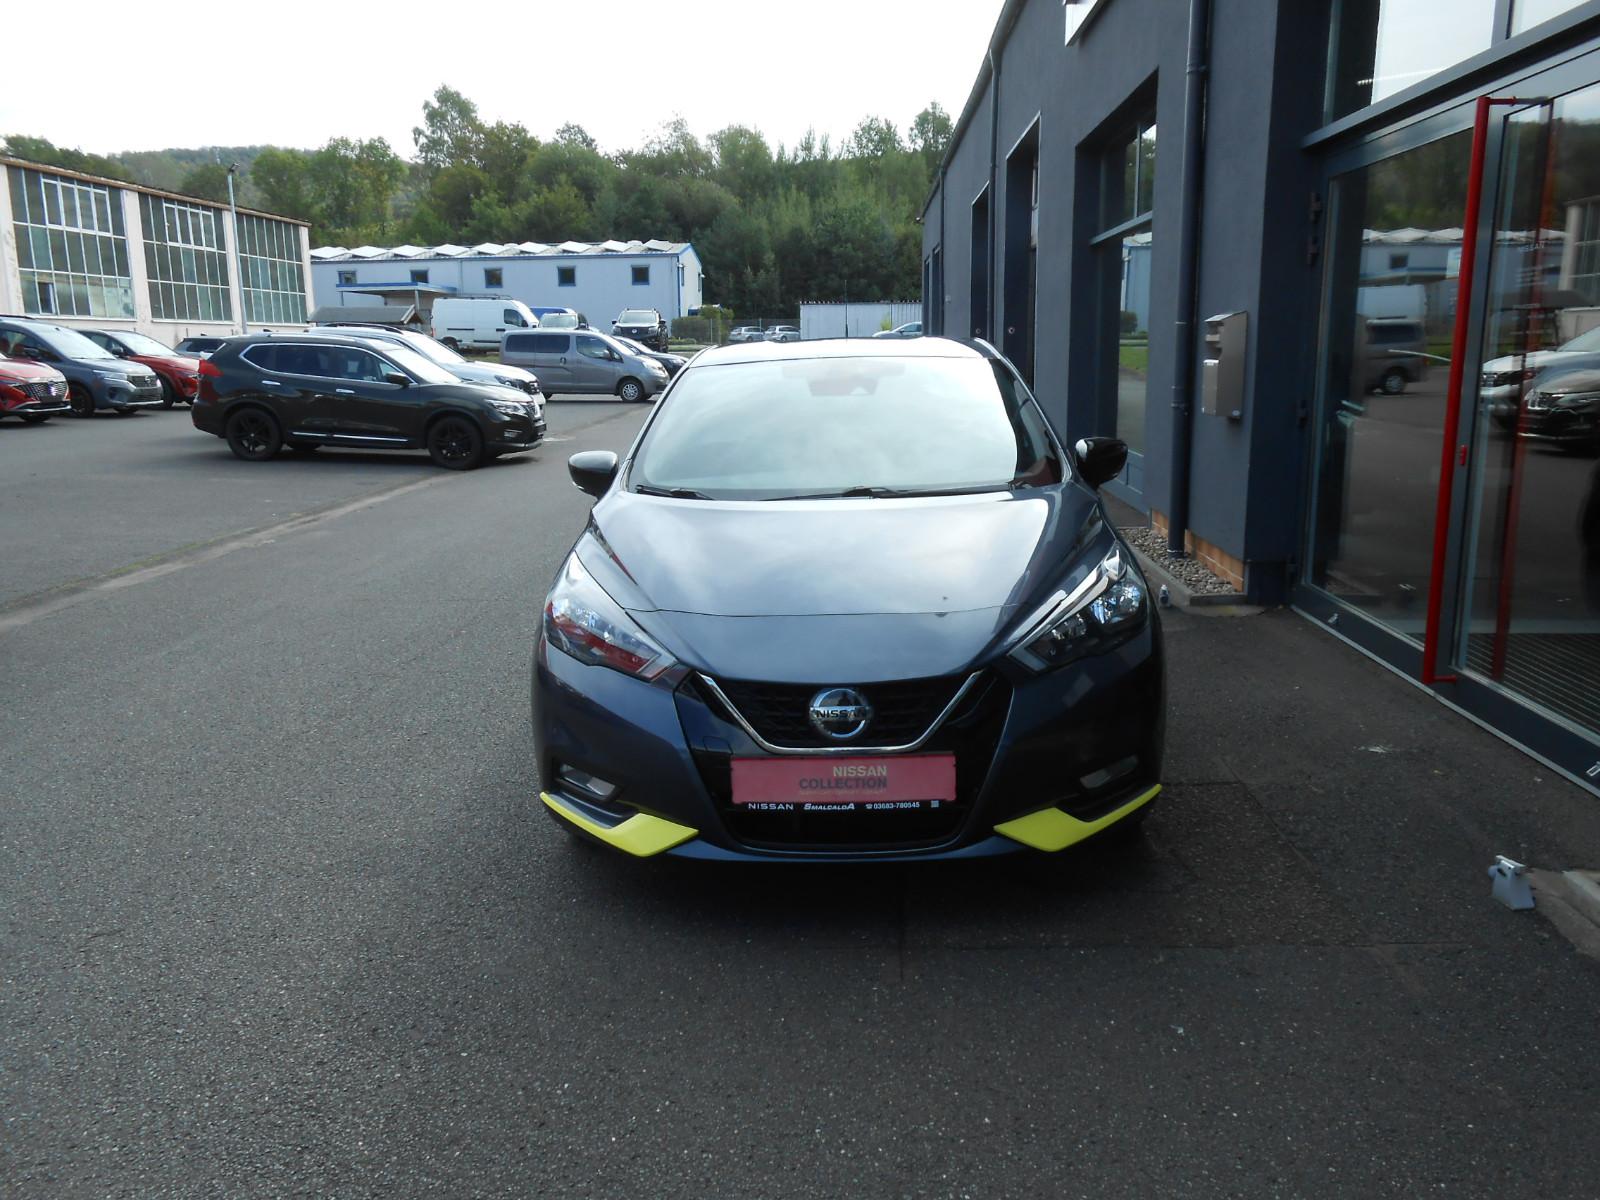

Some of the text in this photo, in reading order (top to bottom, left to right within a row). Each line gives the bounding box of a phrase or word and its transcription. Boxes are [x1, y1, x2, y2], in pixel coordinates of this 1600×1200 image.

[816, 709, 866, 718] NISSAN
[833, 766, 888, 776] NISSAN
[800, 779, 888, 790] COLLECTION
[748, 803, 795, 811] NISSAN
